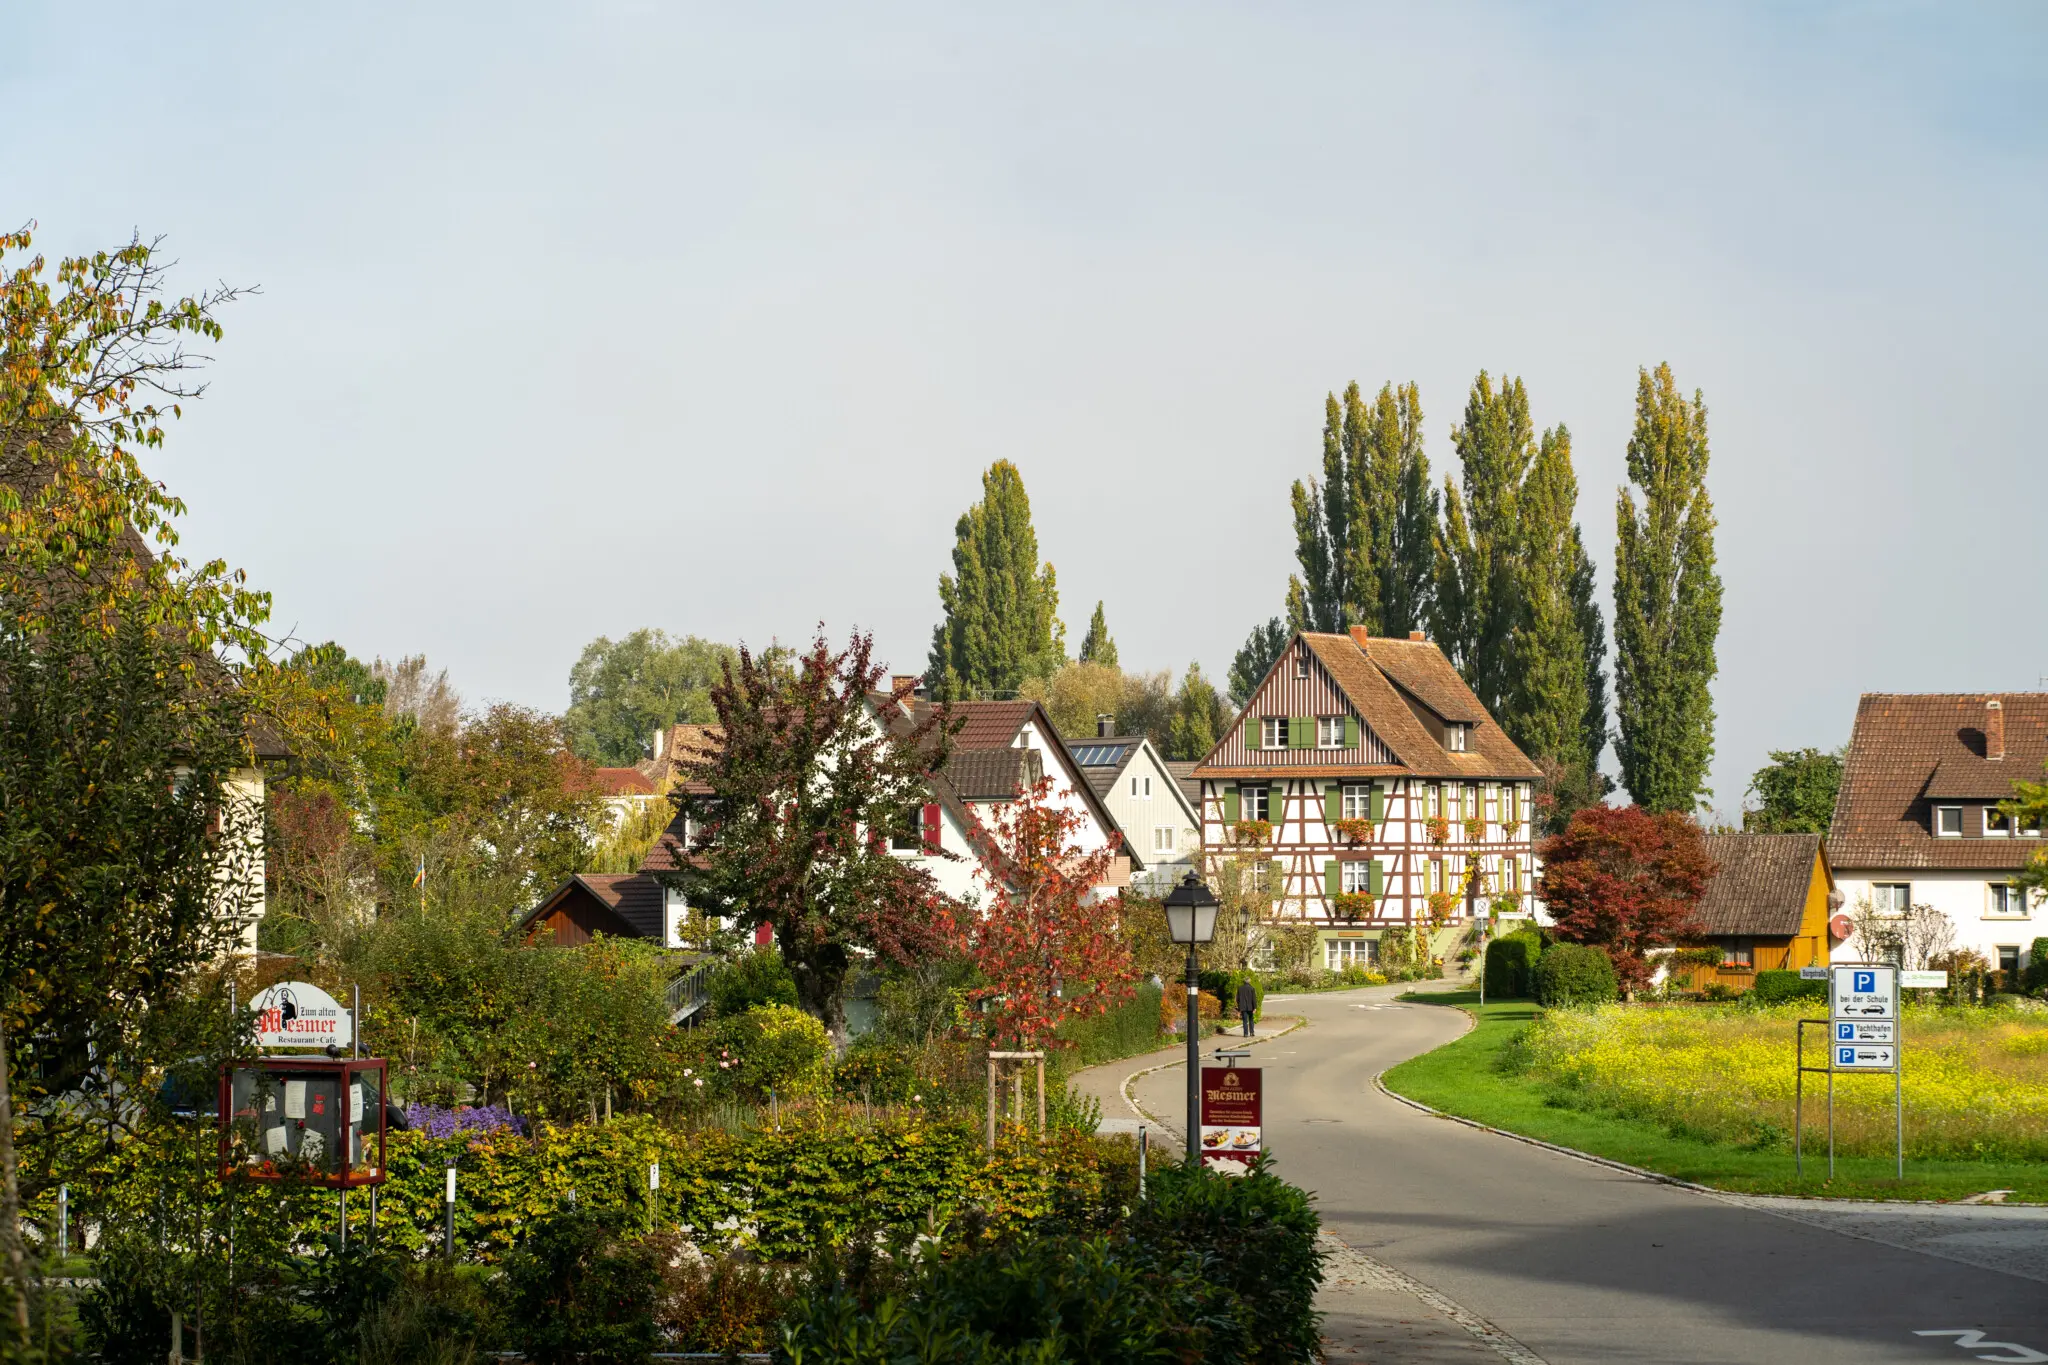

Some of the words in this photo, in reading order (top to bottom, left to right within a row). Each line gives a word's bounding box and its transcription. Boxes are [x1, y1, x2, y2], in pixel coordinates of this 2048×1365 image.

[1858, 974, 1871, 990] P
[1840, 995, 1850, 1003] bei
[1852, 995, 1863, 1003] der
[1866, 995, 1889, 1003] Schule
[300, 1007, 317, 1017] Zum
[318, 1006, 336, 1016] alten
[256, 1005, 336, 1036] Mesmer
[1841, 1025, 1851, 1037] P
[1856, 1024, 1891, 1032] Yachthafen
[1842, 1050, 1852, 1062] P
[1206, 1089, 1256, 1103] Mesmer
